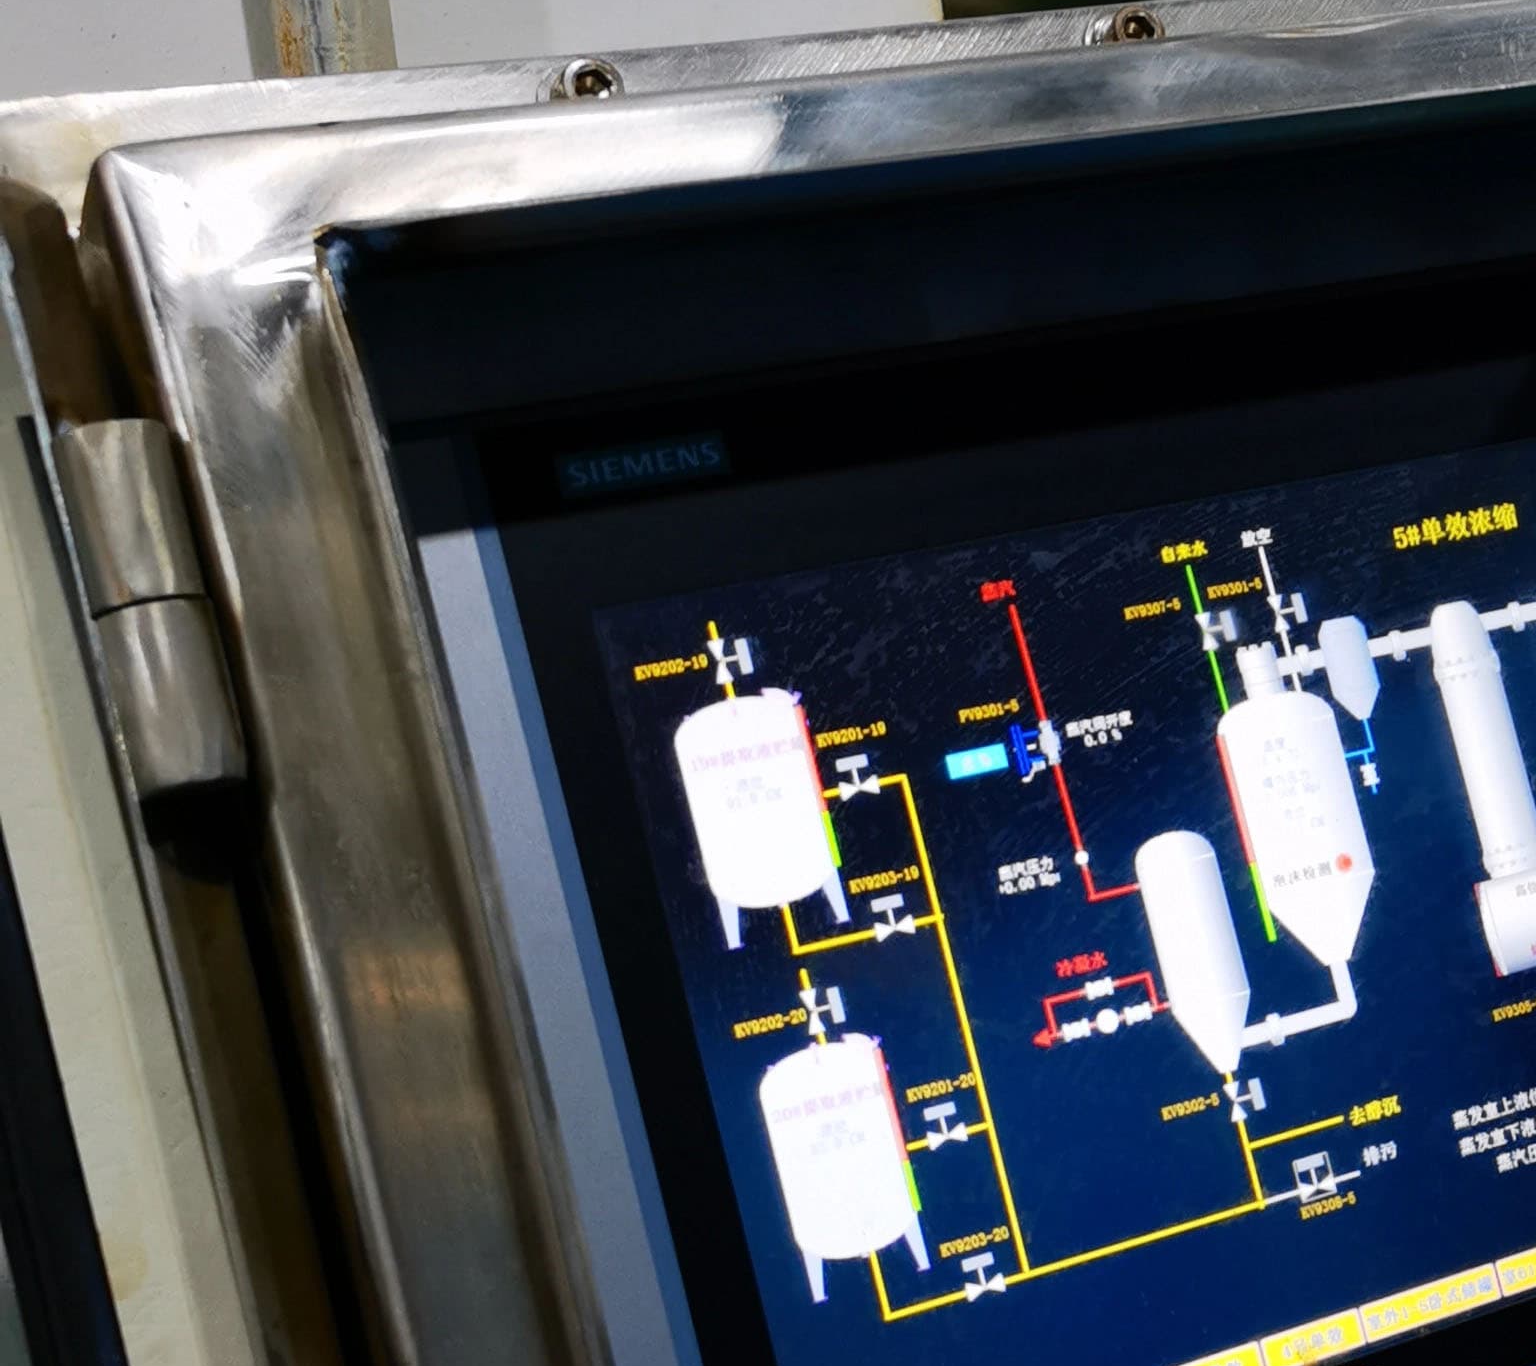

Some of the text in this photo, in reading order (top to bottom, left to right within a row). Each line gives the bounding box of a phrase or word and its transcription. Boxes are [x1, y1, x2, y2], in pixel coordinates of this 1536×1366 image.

[568, 441, 721, 486] SIEMENS
[1392, 502, 1519, 550] 5#单效浓缩
[1160, 540, 1208, 564] 自来水
